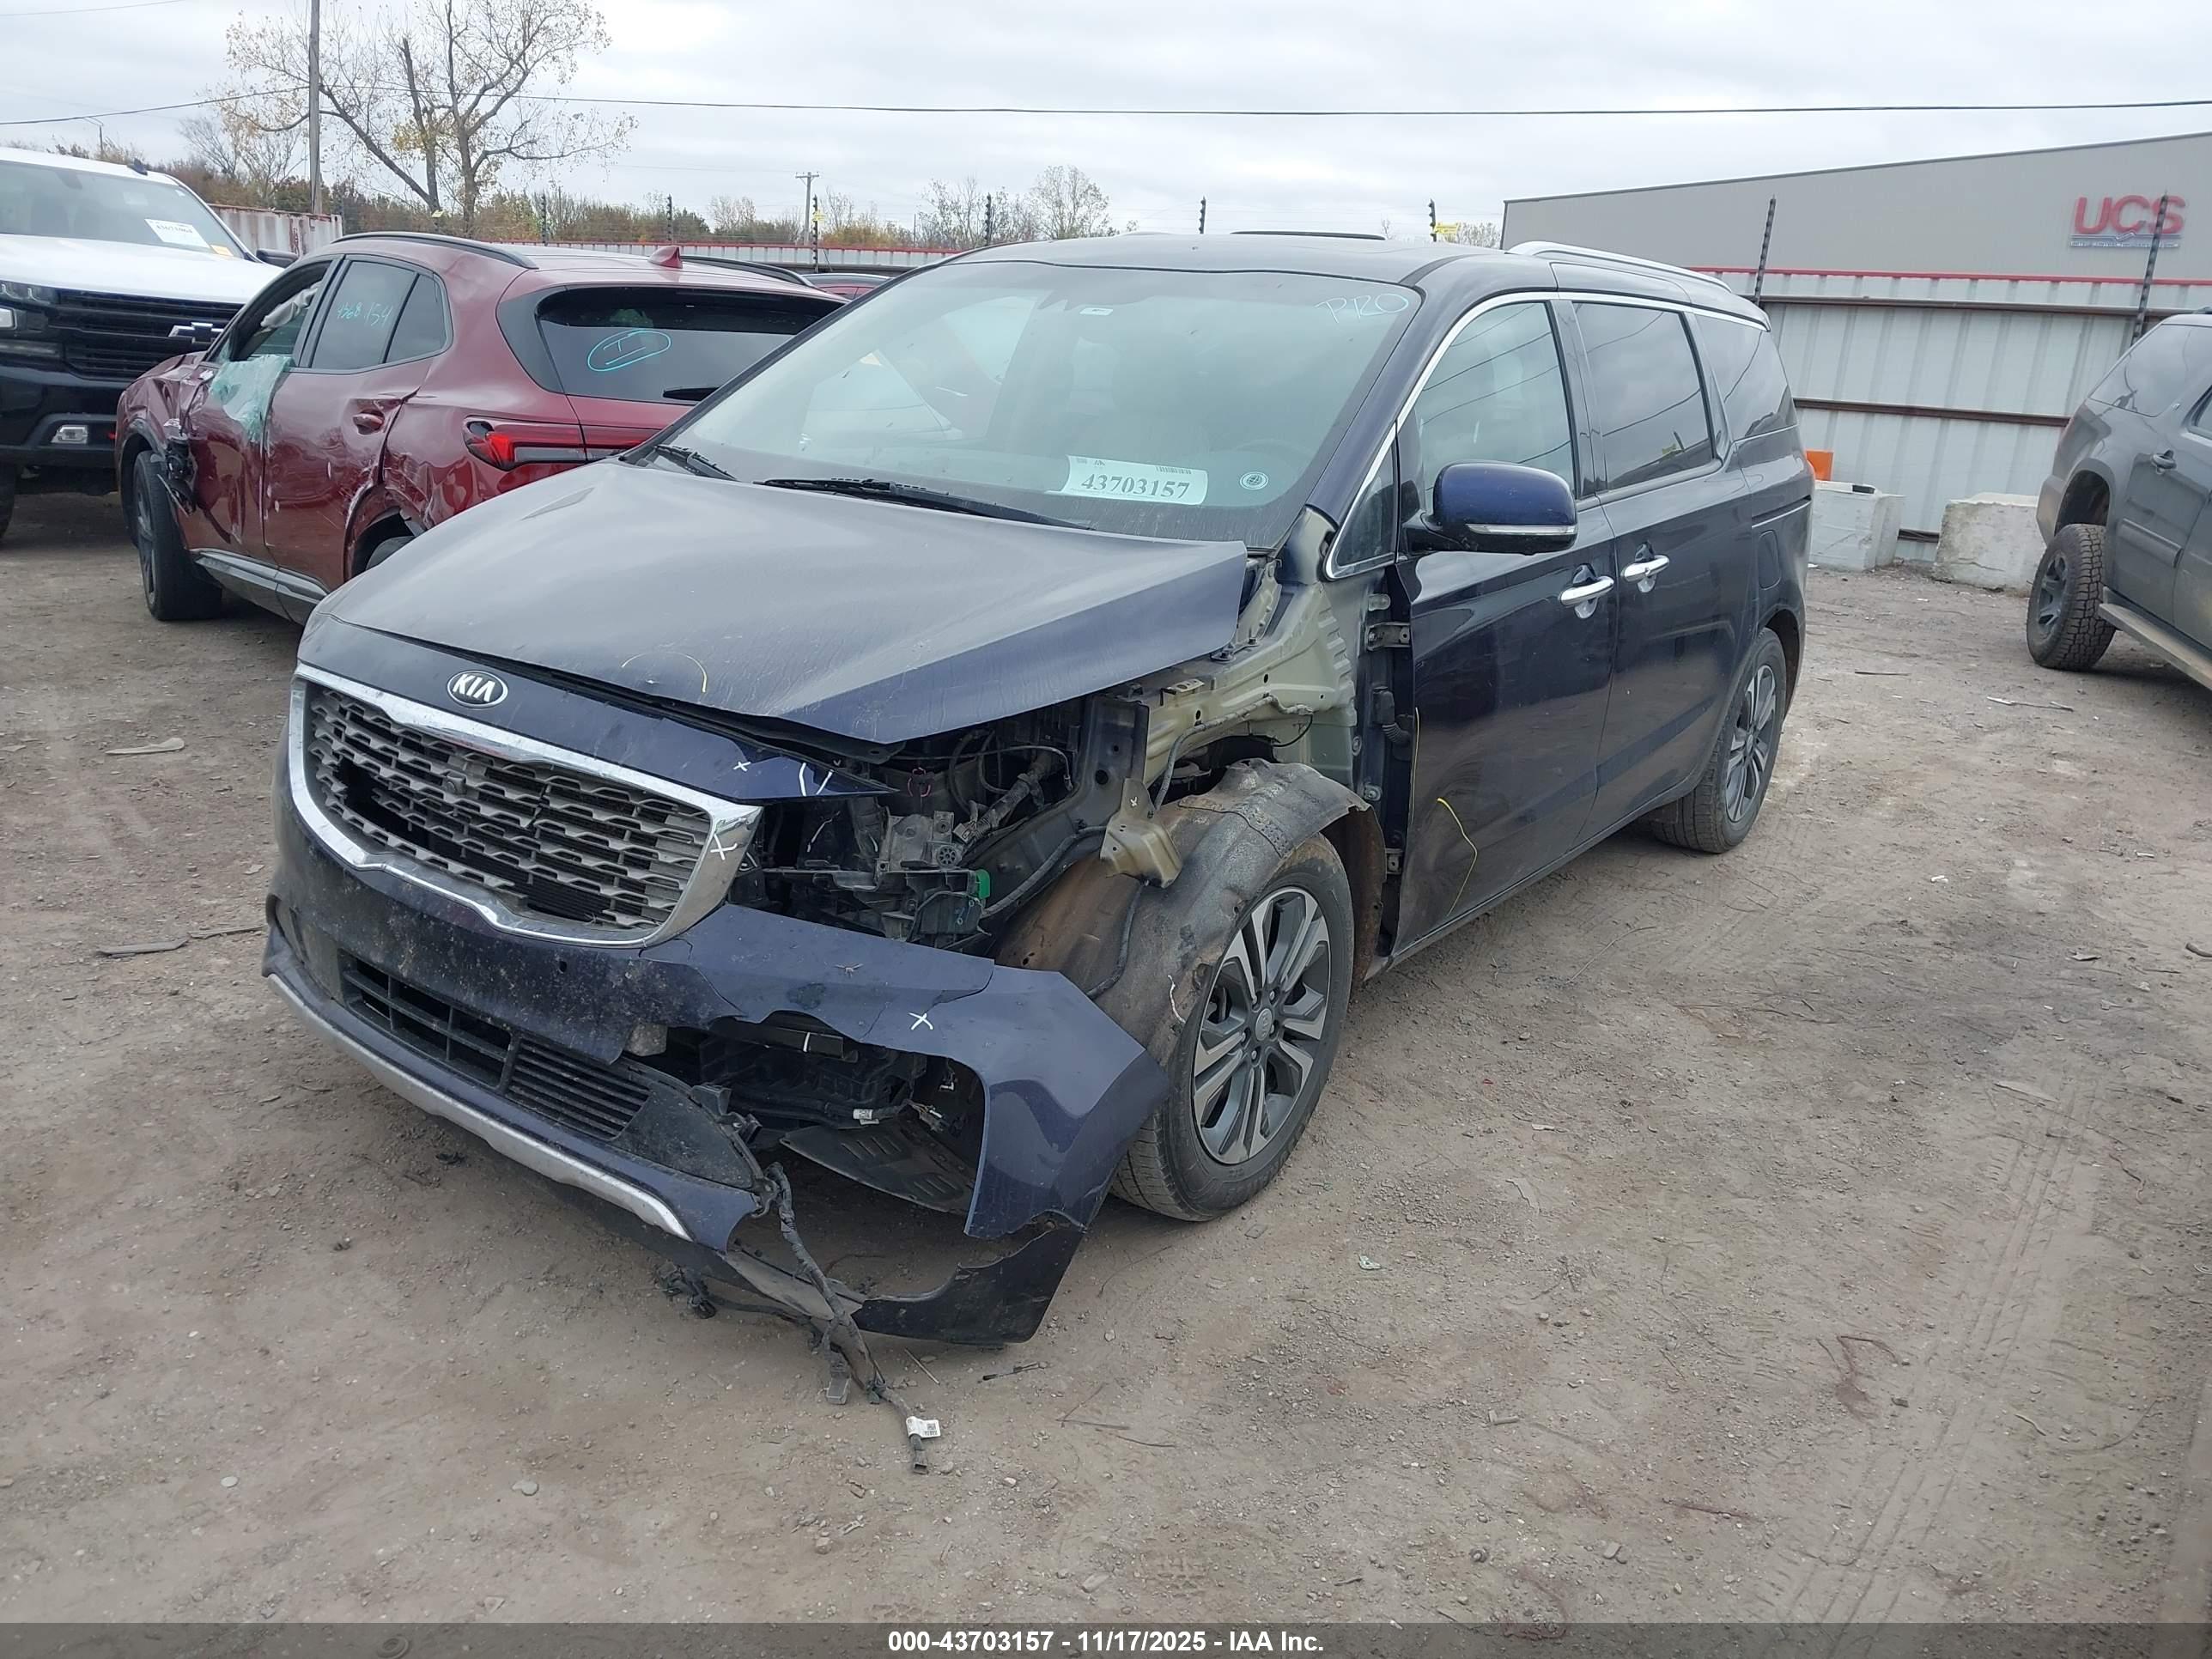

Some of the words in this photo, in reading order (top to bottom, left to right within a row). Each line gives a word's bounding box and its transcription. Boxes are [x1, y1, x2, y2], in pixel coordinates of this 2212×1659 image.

[2074, 194, 2186, 234] UCS
[1080, 473, 1191, 500] 43703157
[452, 673, 496, 702] KIA
